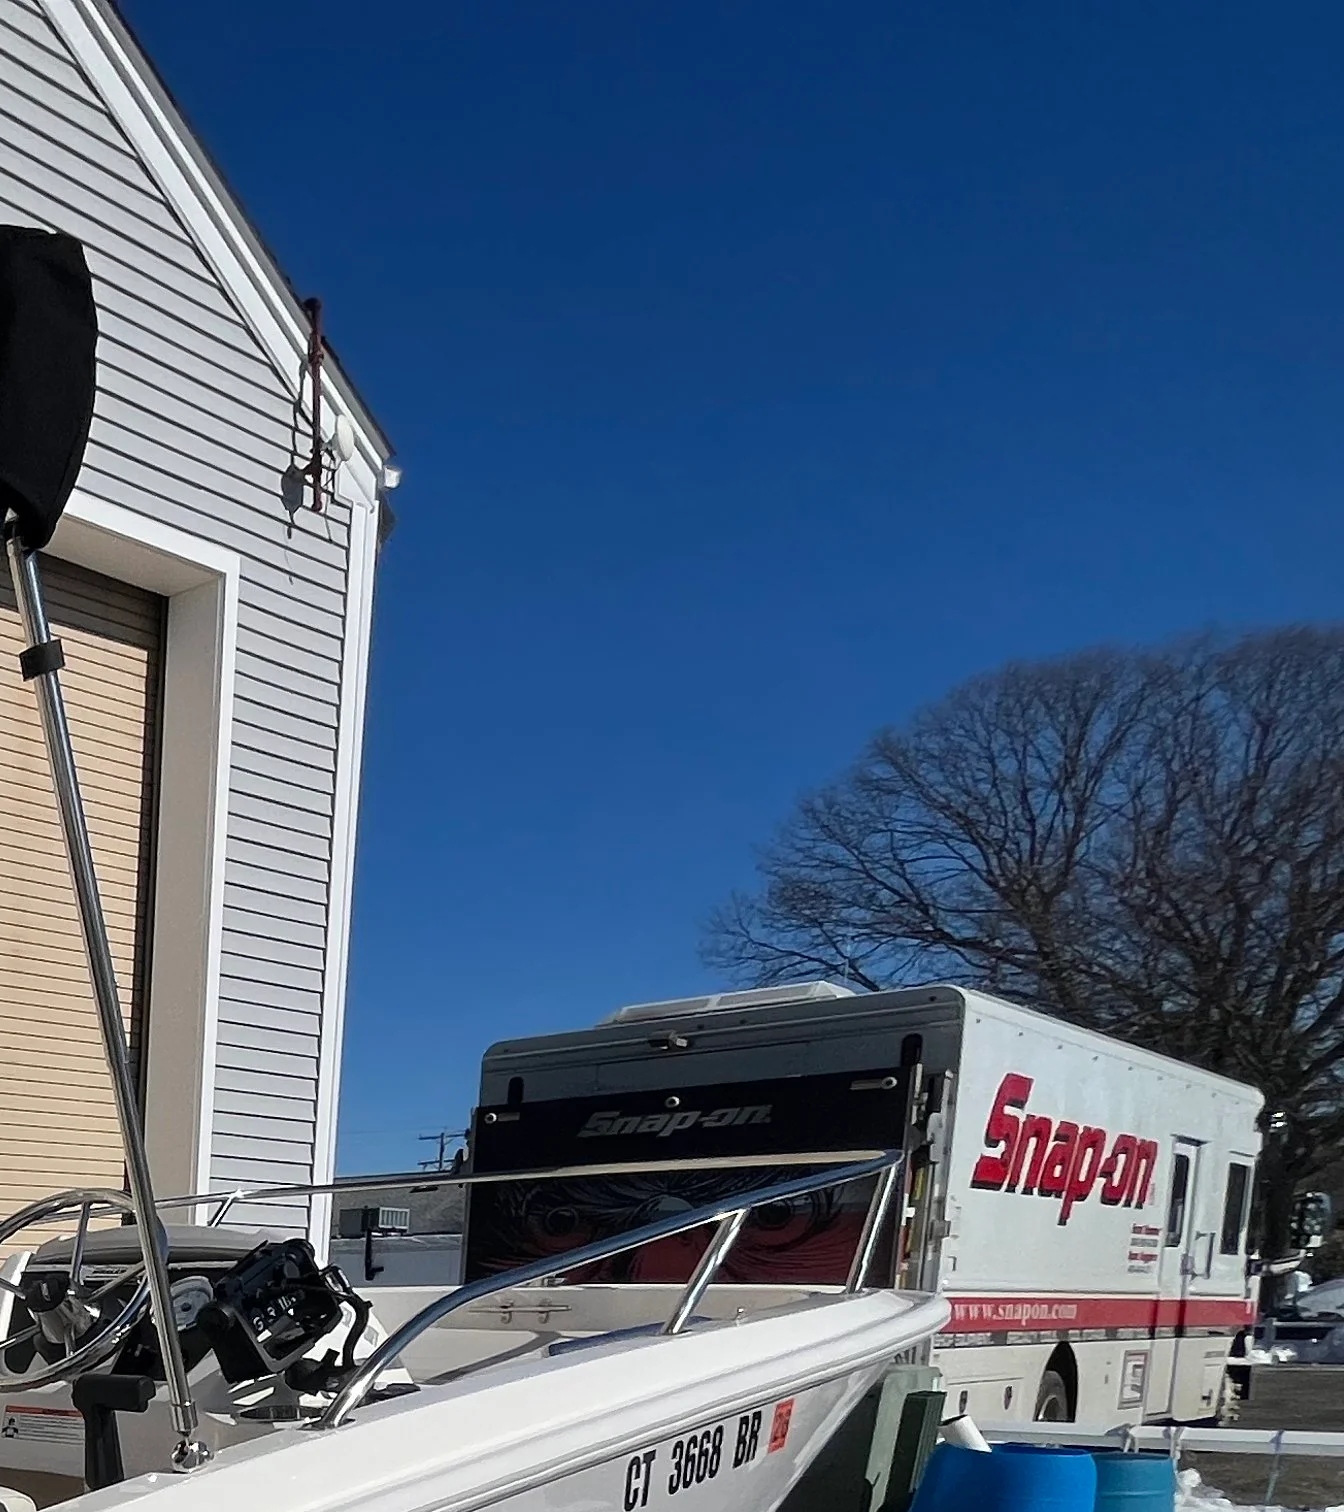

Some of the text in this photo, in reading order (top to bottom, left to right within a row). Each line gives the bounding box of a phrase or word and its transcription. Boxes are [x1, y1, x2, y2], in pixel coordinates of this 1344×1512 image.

[577, 1104, 773, 1138] Snap-on
[968, 1072, 1158, 1226] Snap-on
[954, 1302, 1078, 1325] www.snapon.com
[623, 1449, 657, 1512] CT
[668, 1424, 725, 1494] 3668
[732, 1410, 762, 1469] BR
